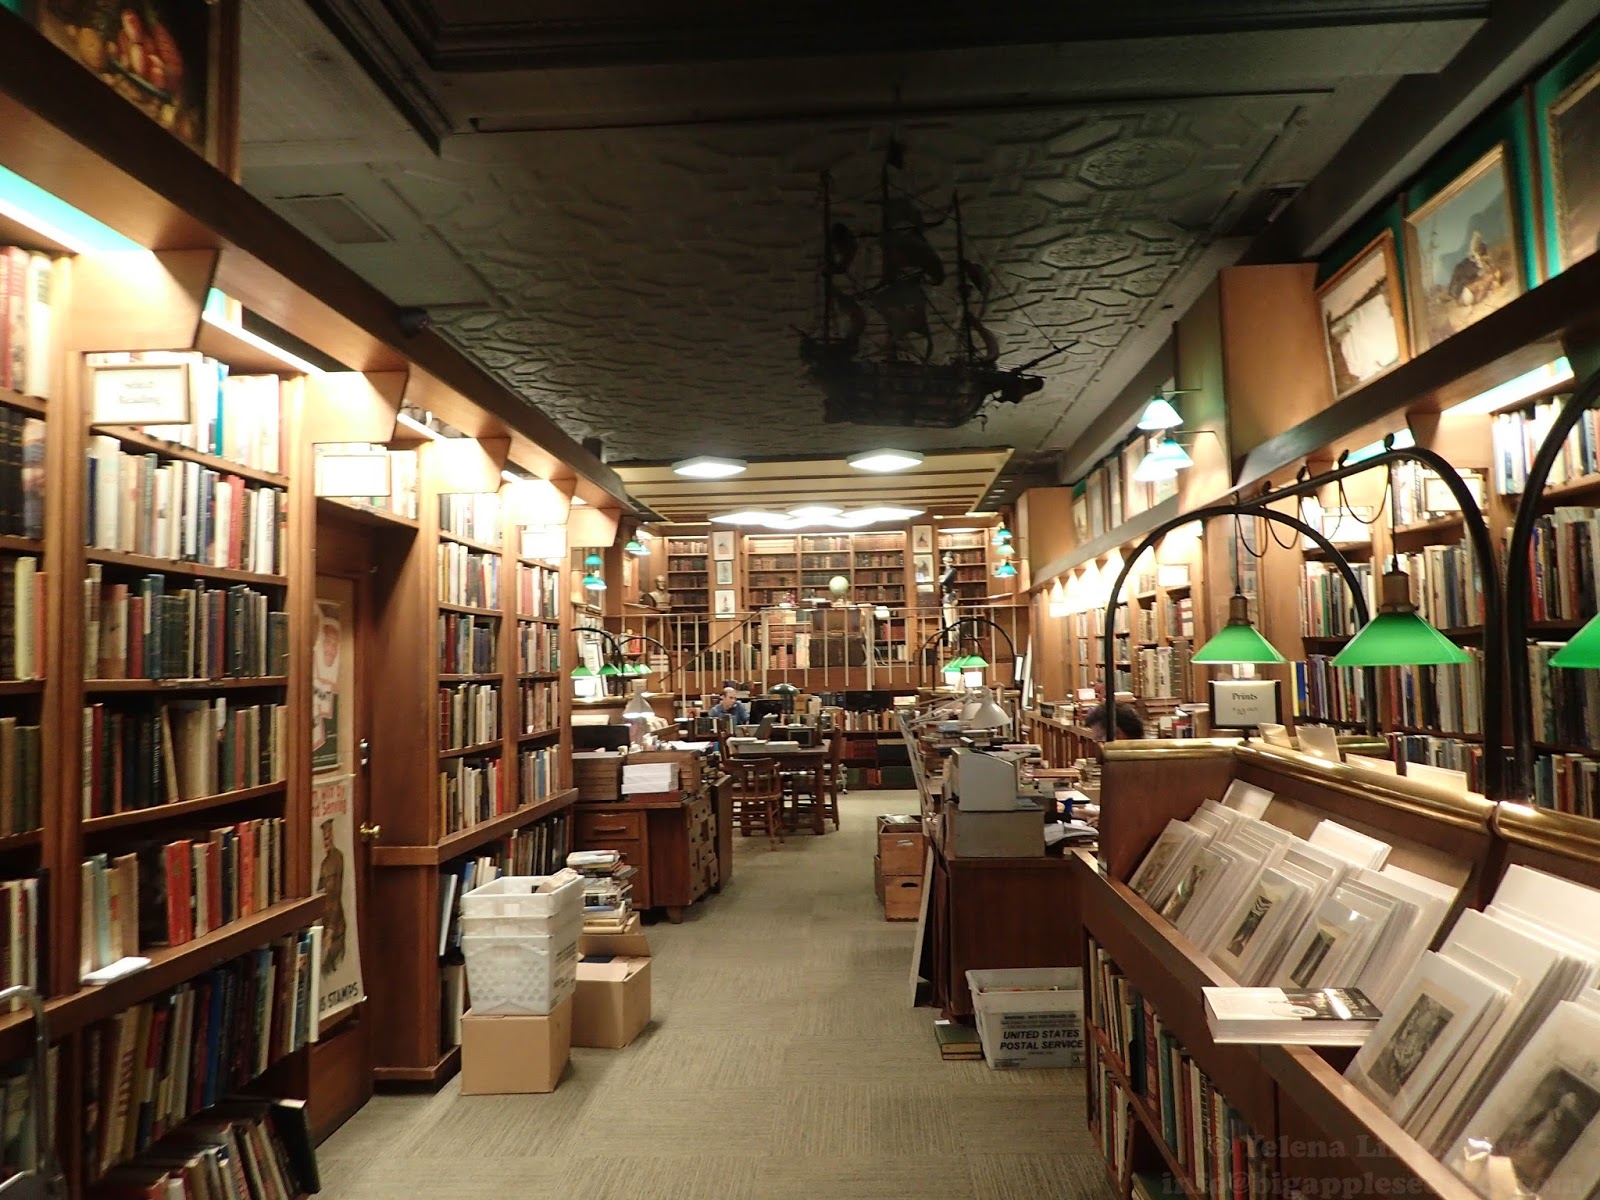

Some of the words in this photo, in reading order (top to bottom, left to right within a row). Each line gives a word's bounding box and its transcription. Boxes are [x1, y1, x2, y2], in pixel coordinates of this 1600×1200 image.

[1232, 692, 1258, 700] Prints
[328, 982, 358, 1007] STAMPS
[1003, 1030, 1039, 1039] UNITED
[1042, 1029, 1079, 1038] STATES
[1000, 1041, 1039, 1050] POSTAL
[1041, 1040, 1084, 1049] SERVICE
